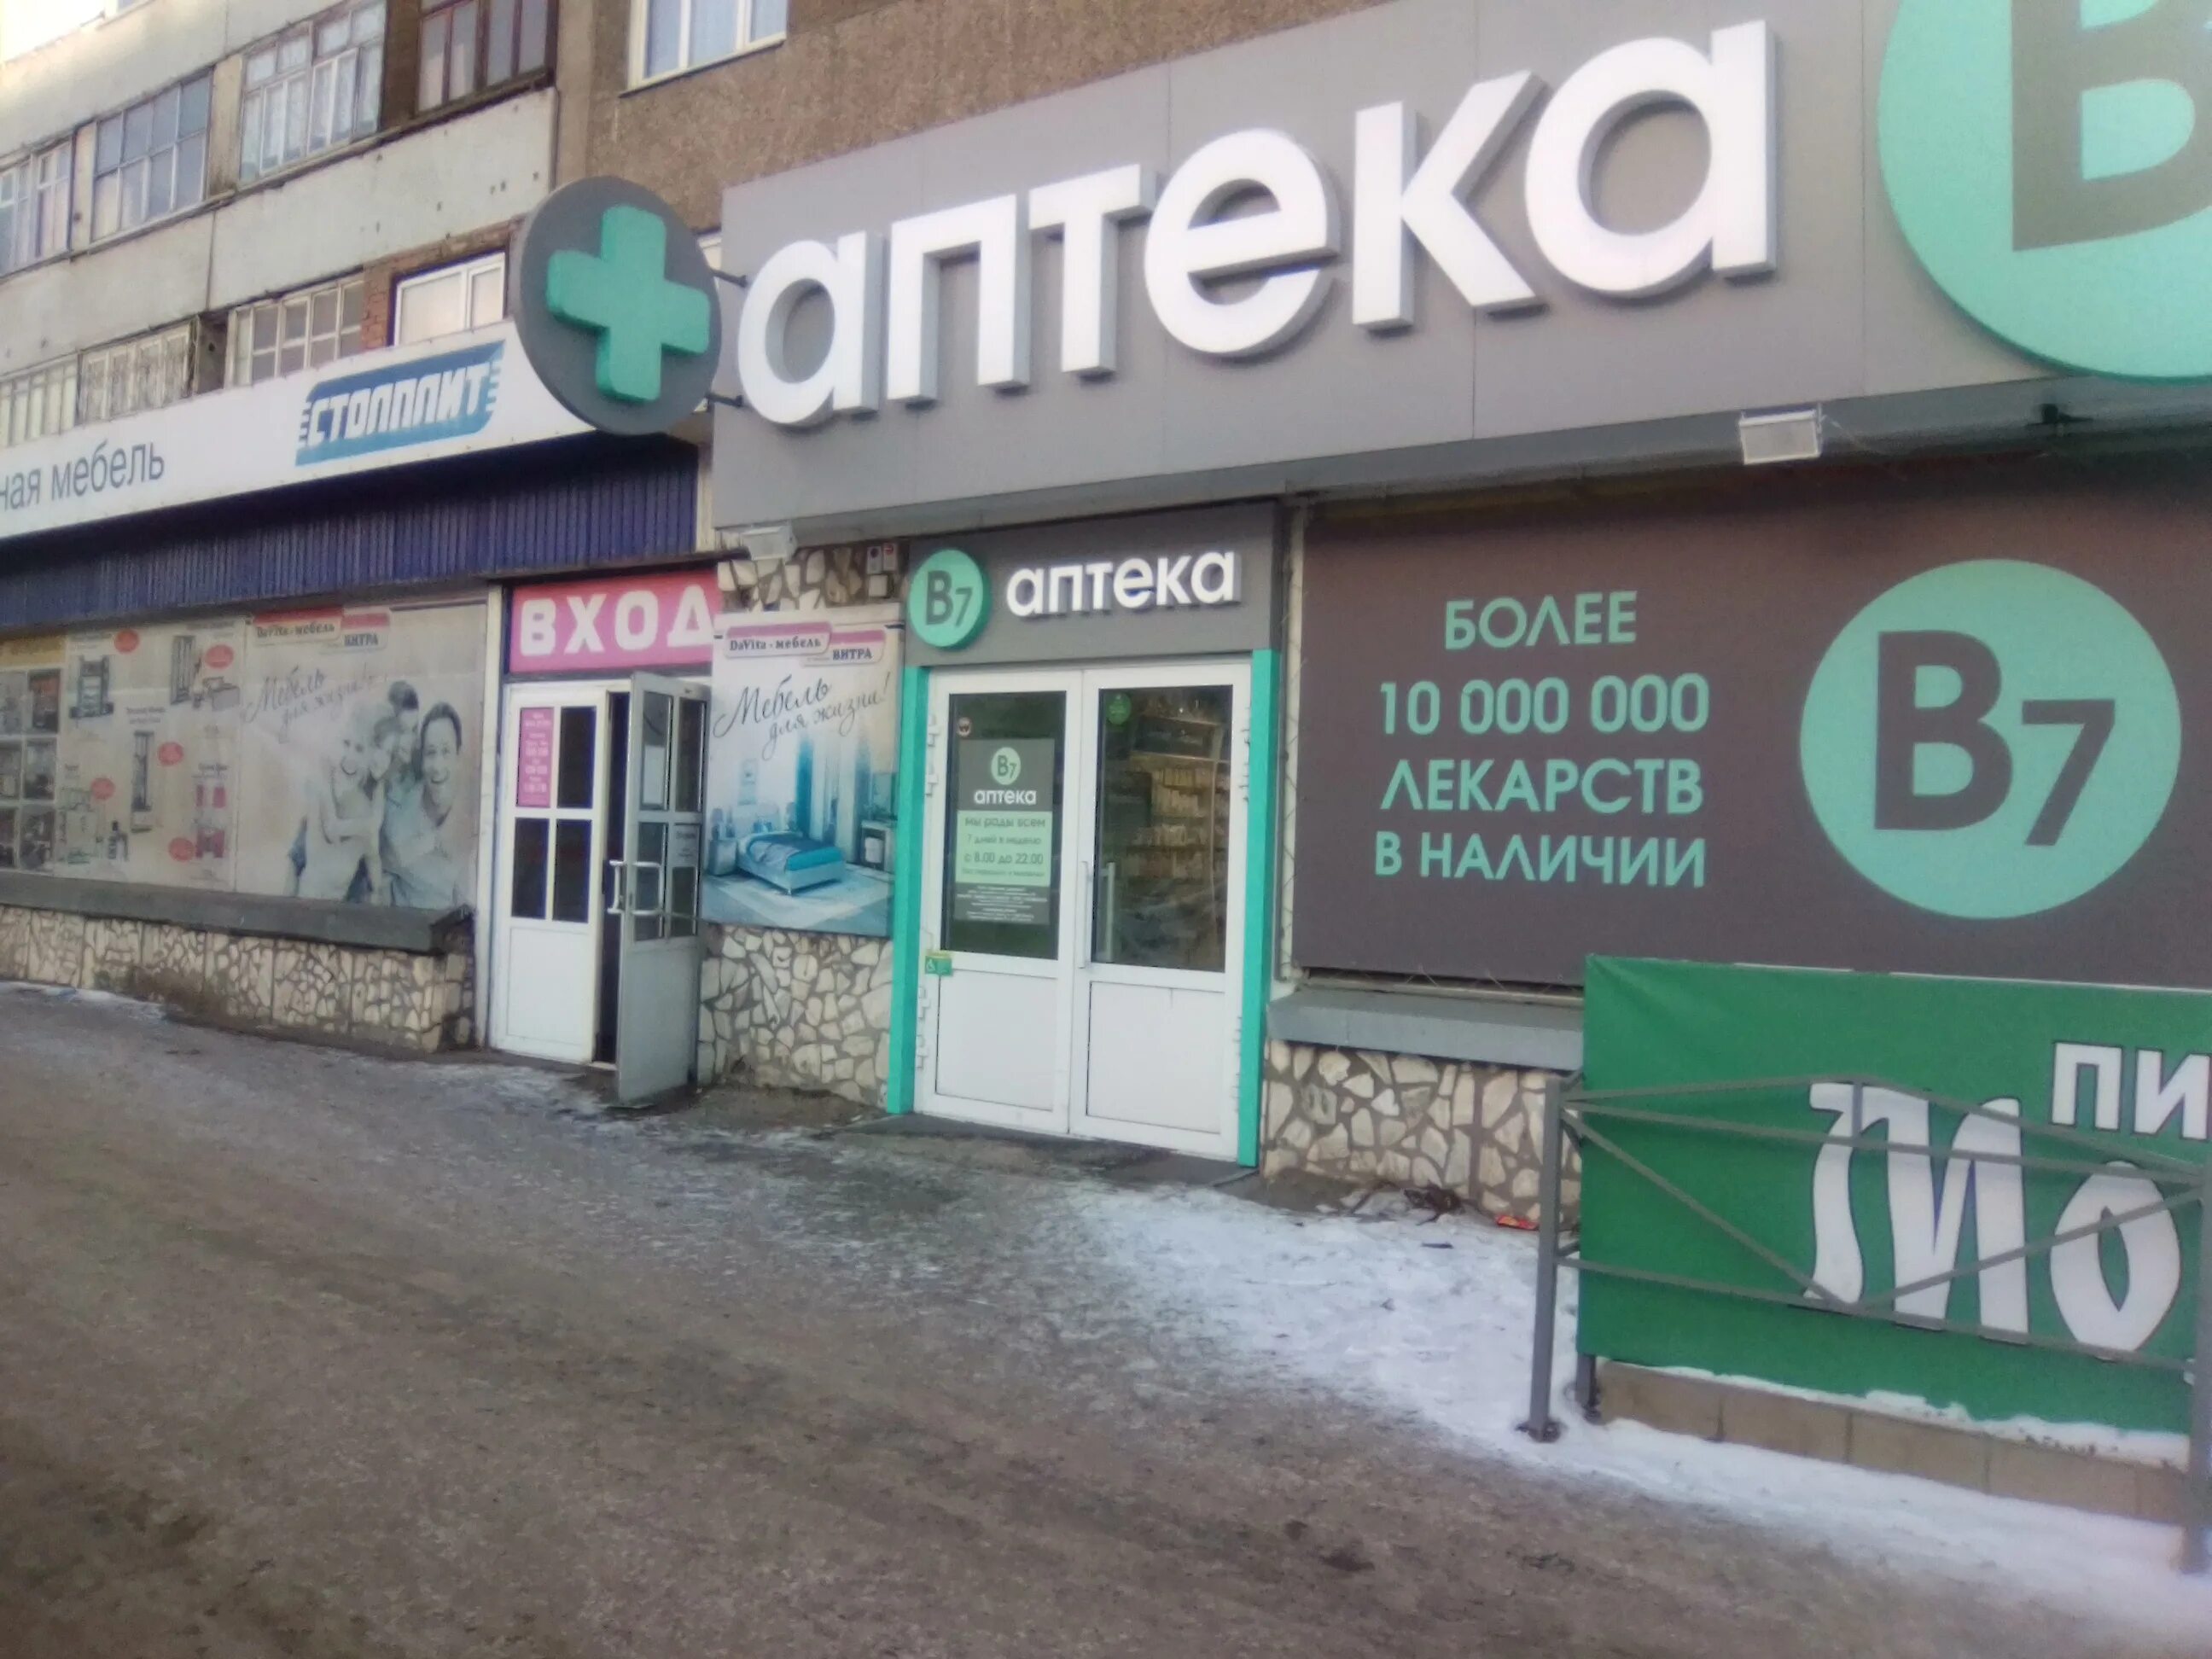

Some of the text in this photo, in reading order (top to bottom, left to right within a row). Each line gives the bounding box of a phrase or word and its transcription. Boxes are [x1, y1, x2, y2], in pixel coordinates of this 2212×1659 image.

[736, 18, 1776, 425] аптека
[51, 439, 165, 501] мебель
[1006, 550, 1237, 618] аптека
[520, 585, 713, 657] ВХОД
[776, 636, 822, 649] мебель
[1444, 590, 1638, 650] БОЛЕЕ
[832, 648, 874, 661] ВИТРА
[713, 673, 833, 738] Мебель
[1379, 672, 1710, 736] 10 000 000
[762, 713, 806, 760] для
[974, 789, 1037, 805] аптека
[1380, 759, 1703, 815] ЛЕКАРСТВ
[998, 855, 1013, 864] до
[1375, 832, 1706, 889] В НАЛИЧИИ
[2051, 1041, 2211, 1141] ПИ
